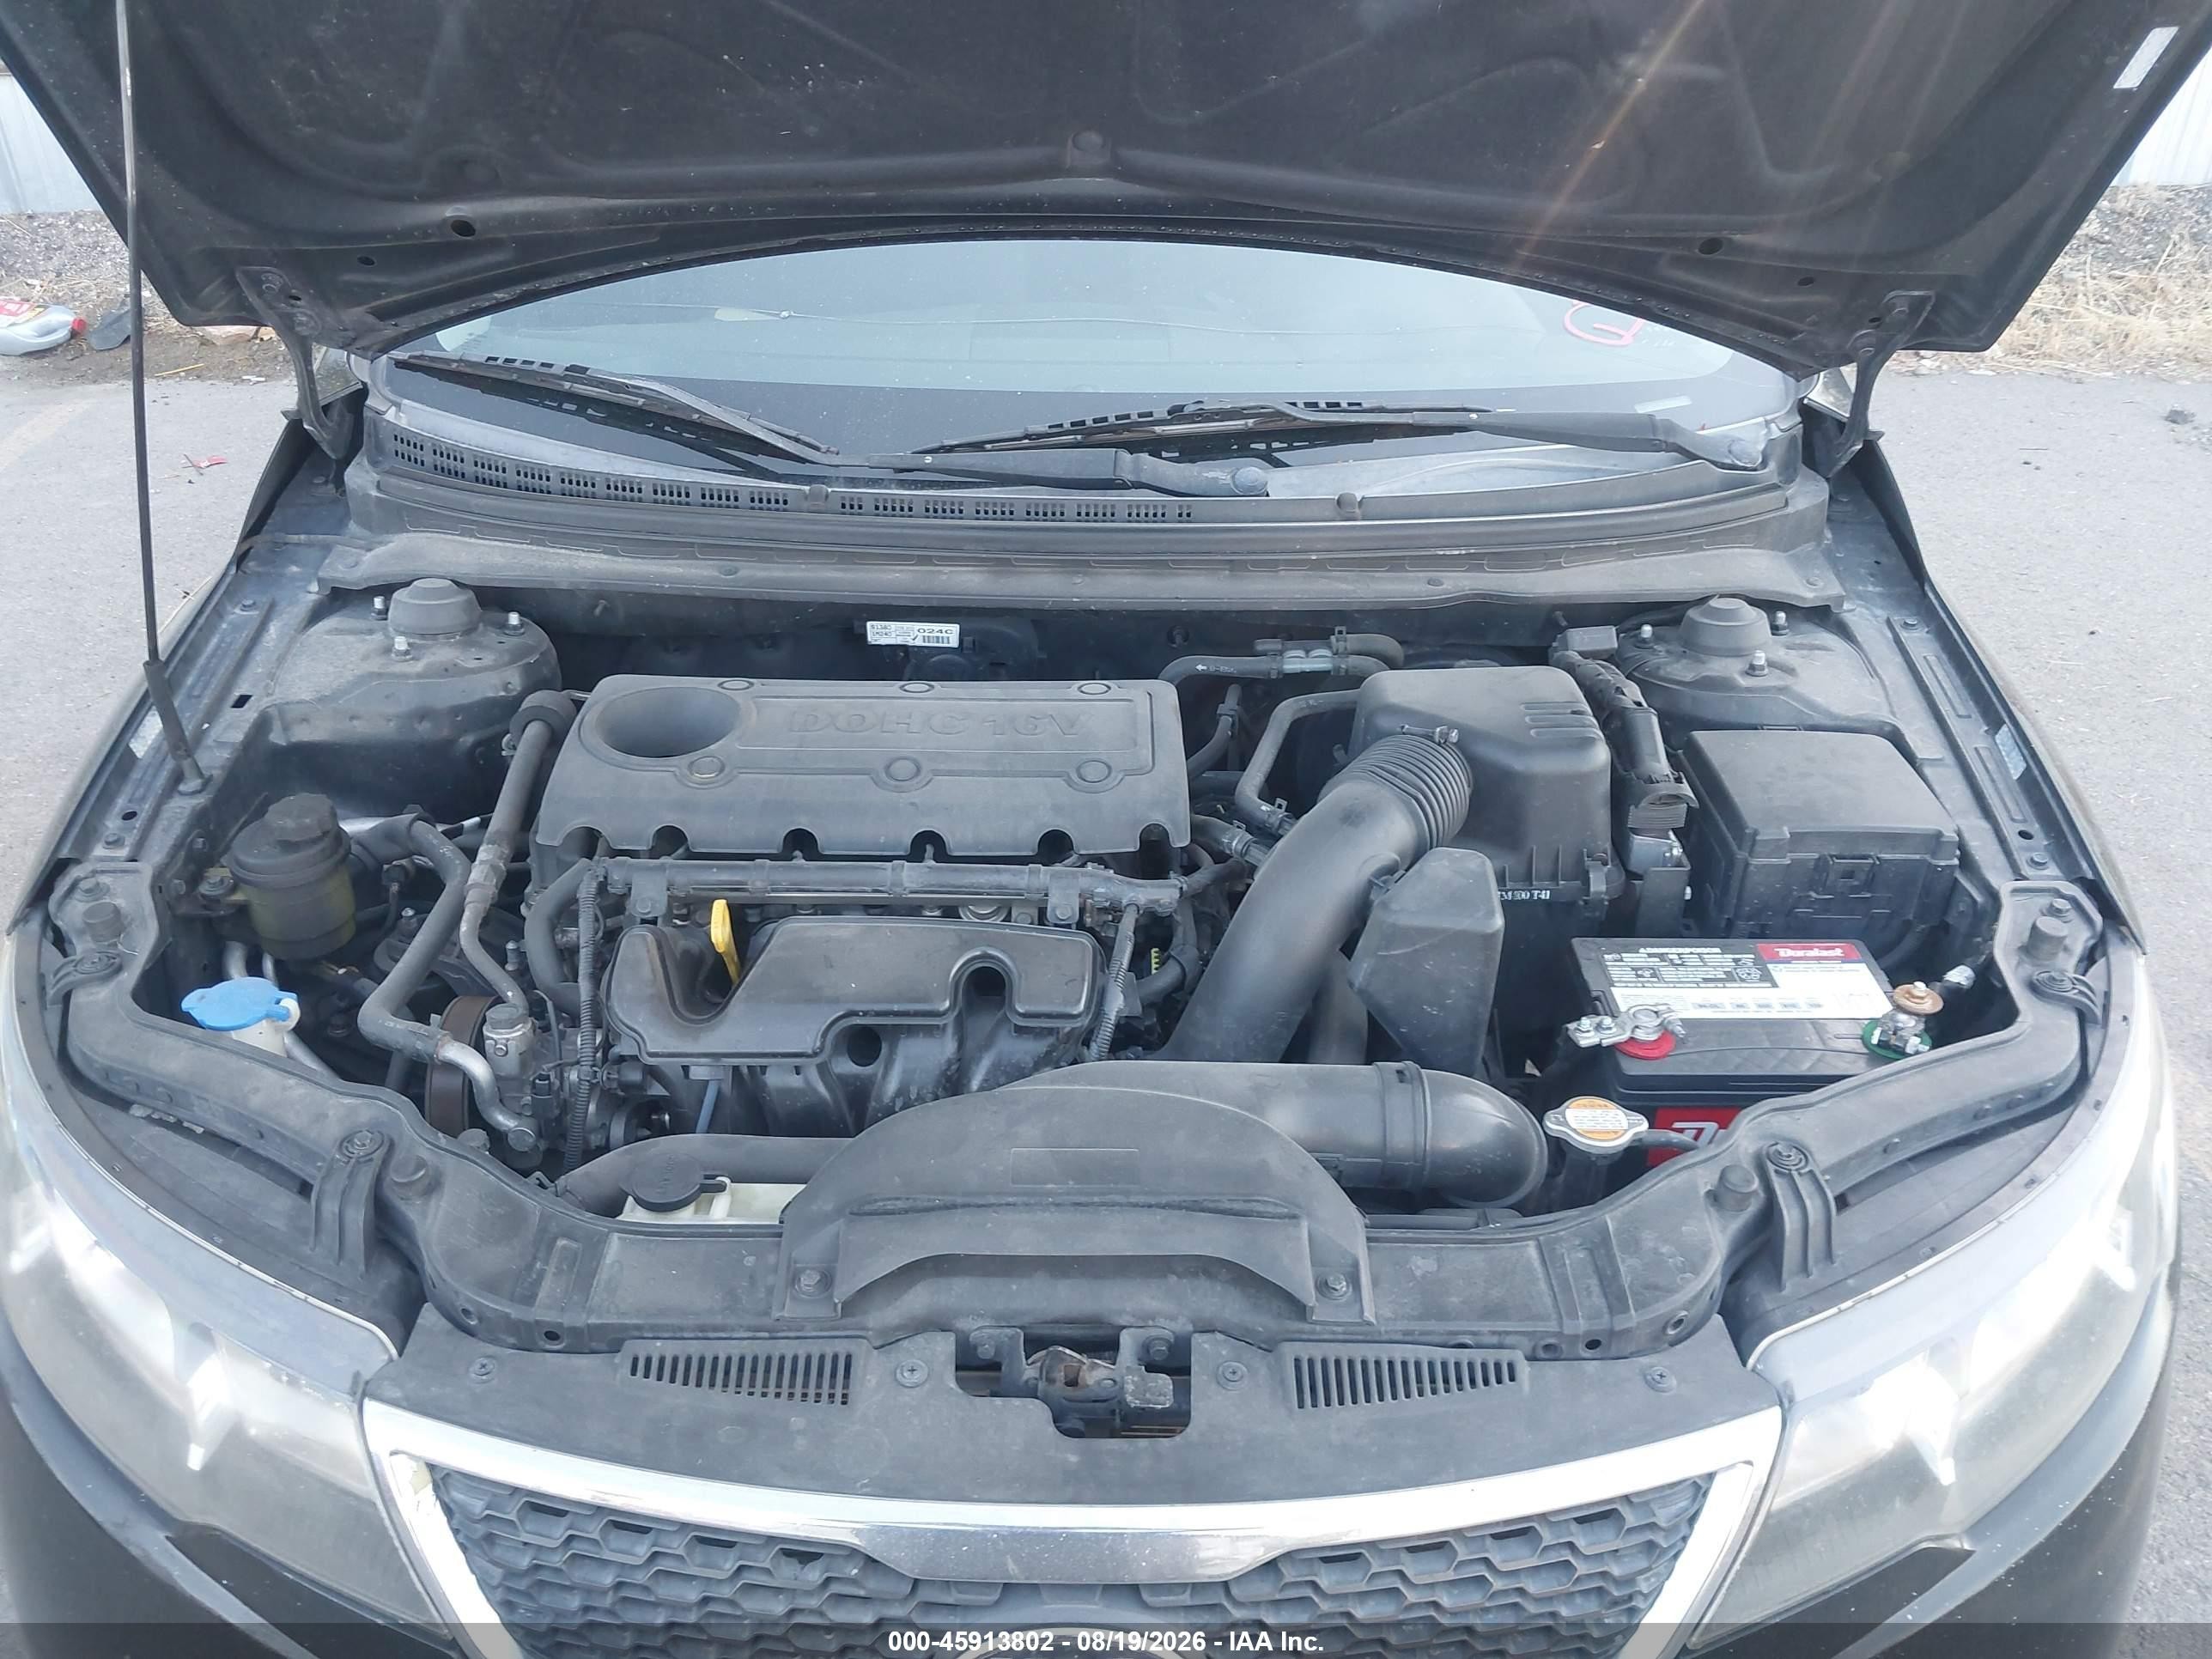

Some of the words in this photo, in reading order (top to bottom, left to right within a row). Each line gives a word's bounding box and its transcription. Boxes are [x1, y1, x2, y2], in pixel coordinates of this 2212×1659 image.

[788, 708, 970, 736] DOHC
[982, 712, 1092, 737] 16V
[1774, 947, 1845, 957] Duralast
